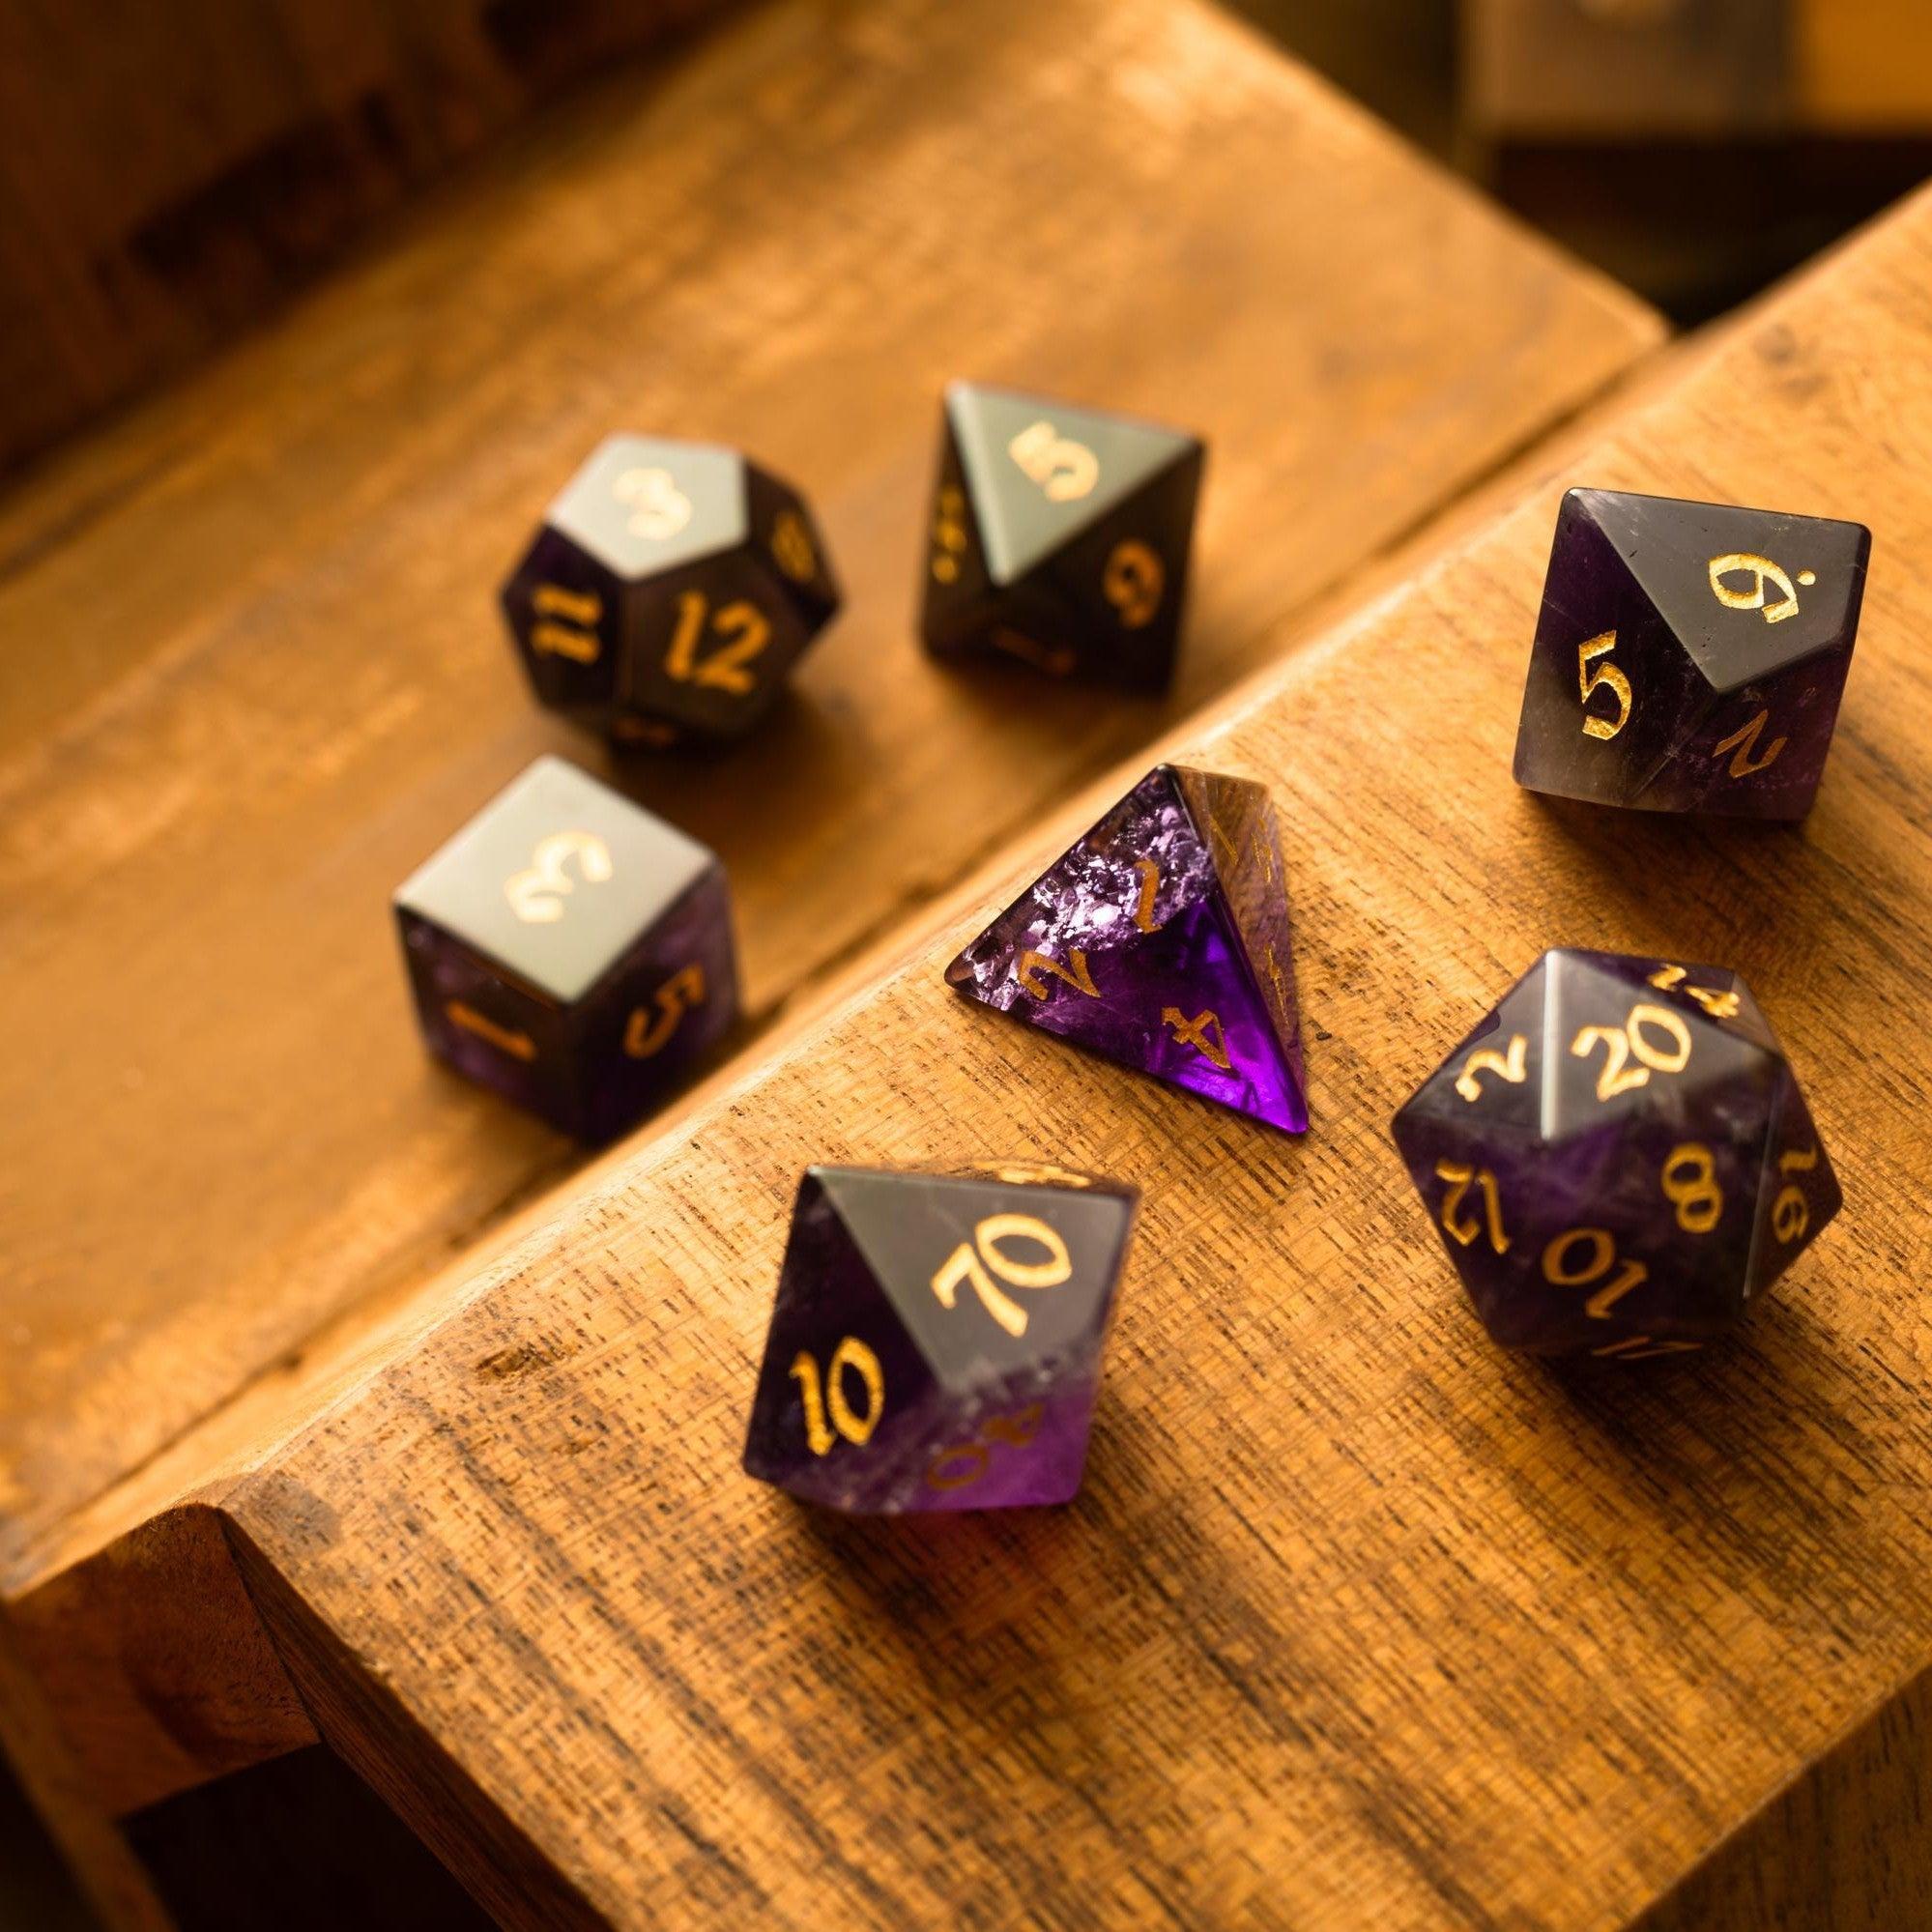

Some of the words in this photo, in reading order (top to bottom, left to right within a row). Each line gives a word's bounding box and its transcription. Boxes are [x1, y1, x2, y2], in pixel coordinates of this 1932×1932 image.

[612, 467, 692, 541] 3
[1008, 419, 1099, 503] 5
[667, 591, 770, 694] 12
[1577, 629, 1633, 741] 5
[503, 830, 614, 924] 3
[1131, 858, 1164, 935] 1
[1018, 948, 1102, 1001] 2
[1163, 1006, 1232, 1069] 4
[1455, 1033, 1528, 1103] 2
[1570, 1004, 1693, 1103] 20
[1660, 1143, 1724, 1234] 8
[931, 1212, 1073, 1339] 70
[1543, 1227, 1649, 1320] 10
[788, 1334, 886, 1457] 10
